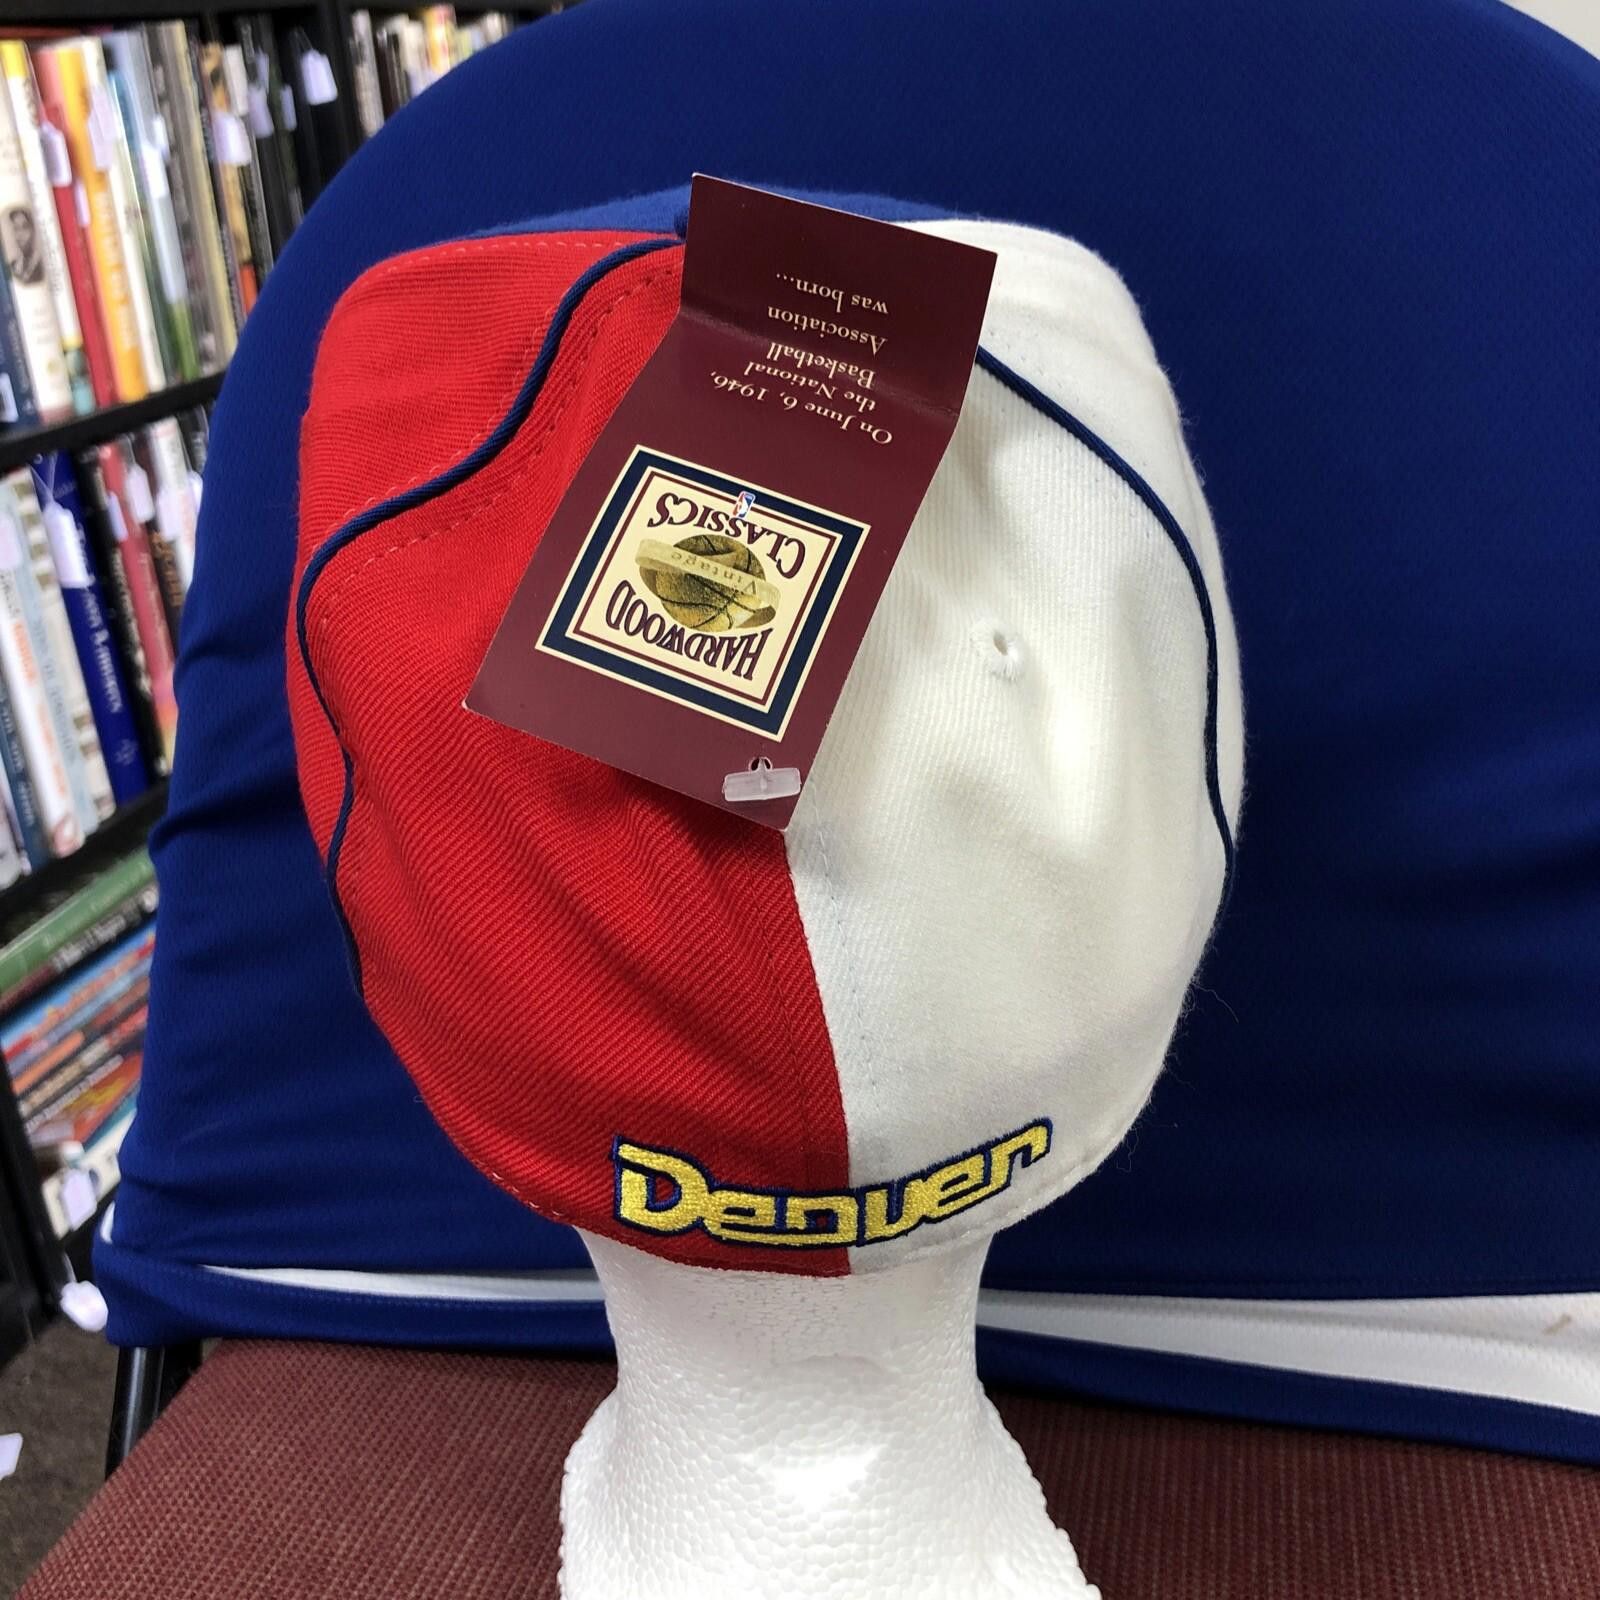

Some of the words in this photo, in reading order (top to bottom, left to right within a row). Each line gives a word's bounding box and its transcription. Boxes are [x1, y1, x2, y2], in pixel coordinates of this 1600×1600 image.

[776, 273, 845, 313] born...
[851, 294, 889, 315] was
[767, 306, 888, 359] Association
[743, 361, 838, 401] National
[766, 341, 877, 390] Basketball
[710, 371, 770, 401] 1946,
[779, 391, 798, 411] 6,
[843, 391, 877, 413] the
[804, 402, 856, 431] June
[859, 421, 893, 445] On
[646, 492, 806, 579] CLASSICS
[670, 552, 757, 595] Vintage
[605, 579, 774, 681] HARDWOOD
[611, 1117, 1053, 1246] Denver
